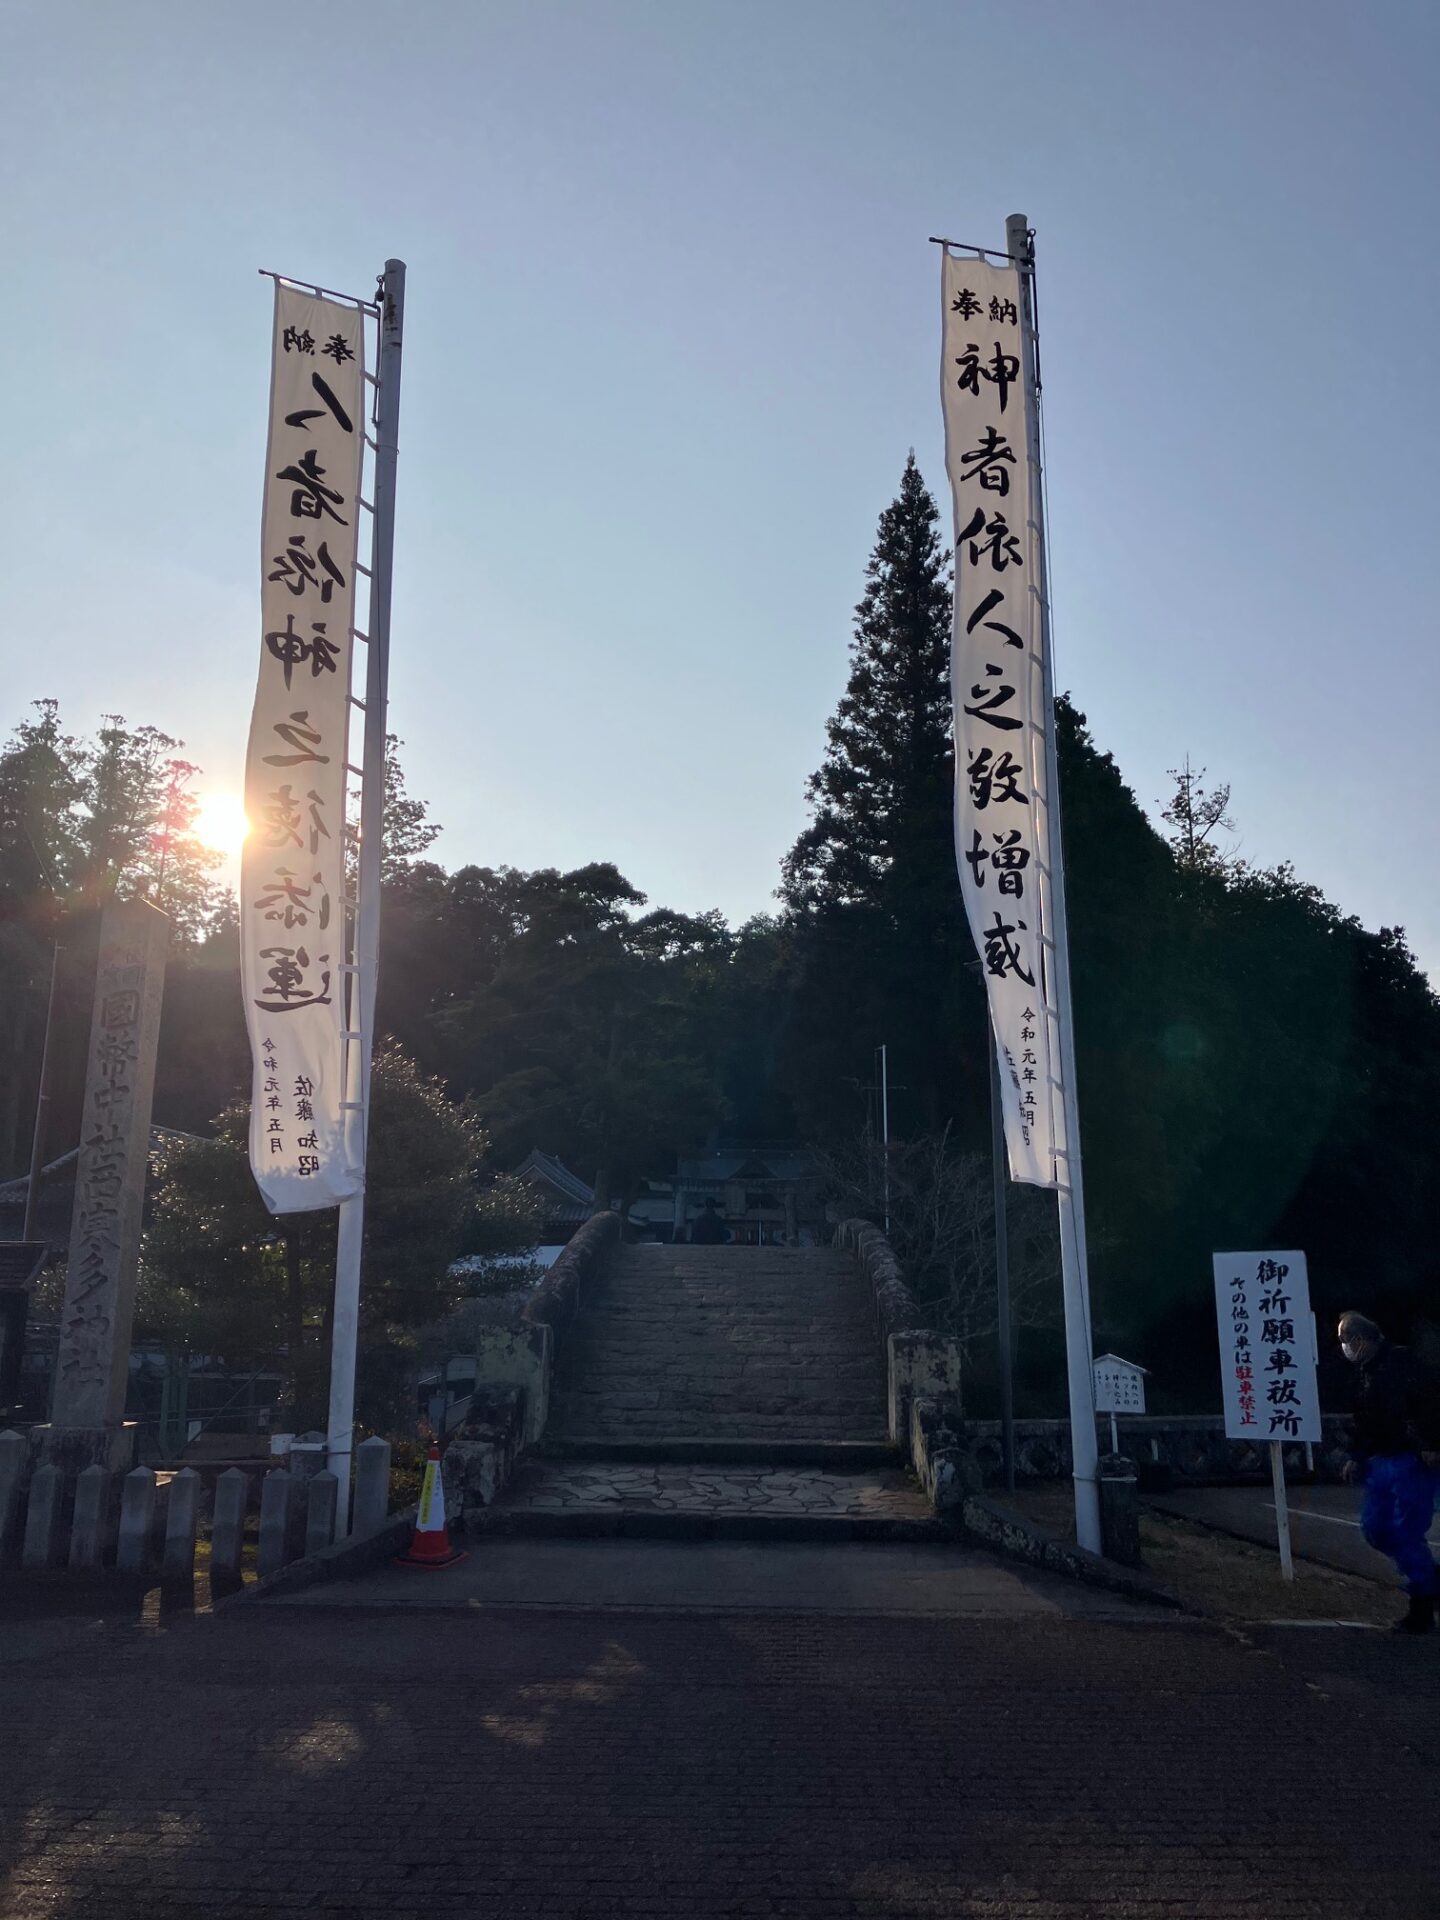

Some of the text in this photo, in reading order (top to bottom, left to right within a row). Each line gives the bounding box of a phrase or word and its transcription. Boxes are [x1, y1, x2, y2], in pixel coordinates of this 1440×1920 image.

[951, 289, 1018, 326] 奉納
[1020, 1006, 1038, 1127] 令和元年五月
[1256, 1258, 1303, 1436] 御祈願車祓所
